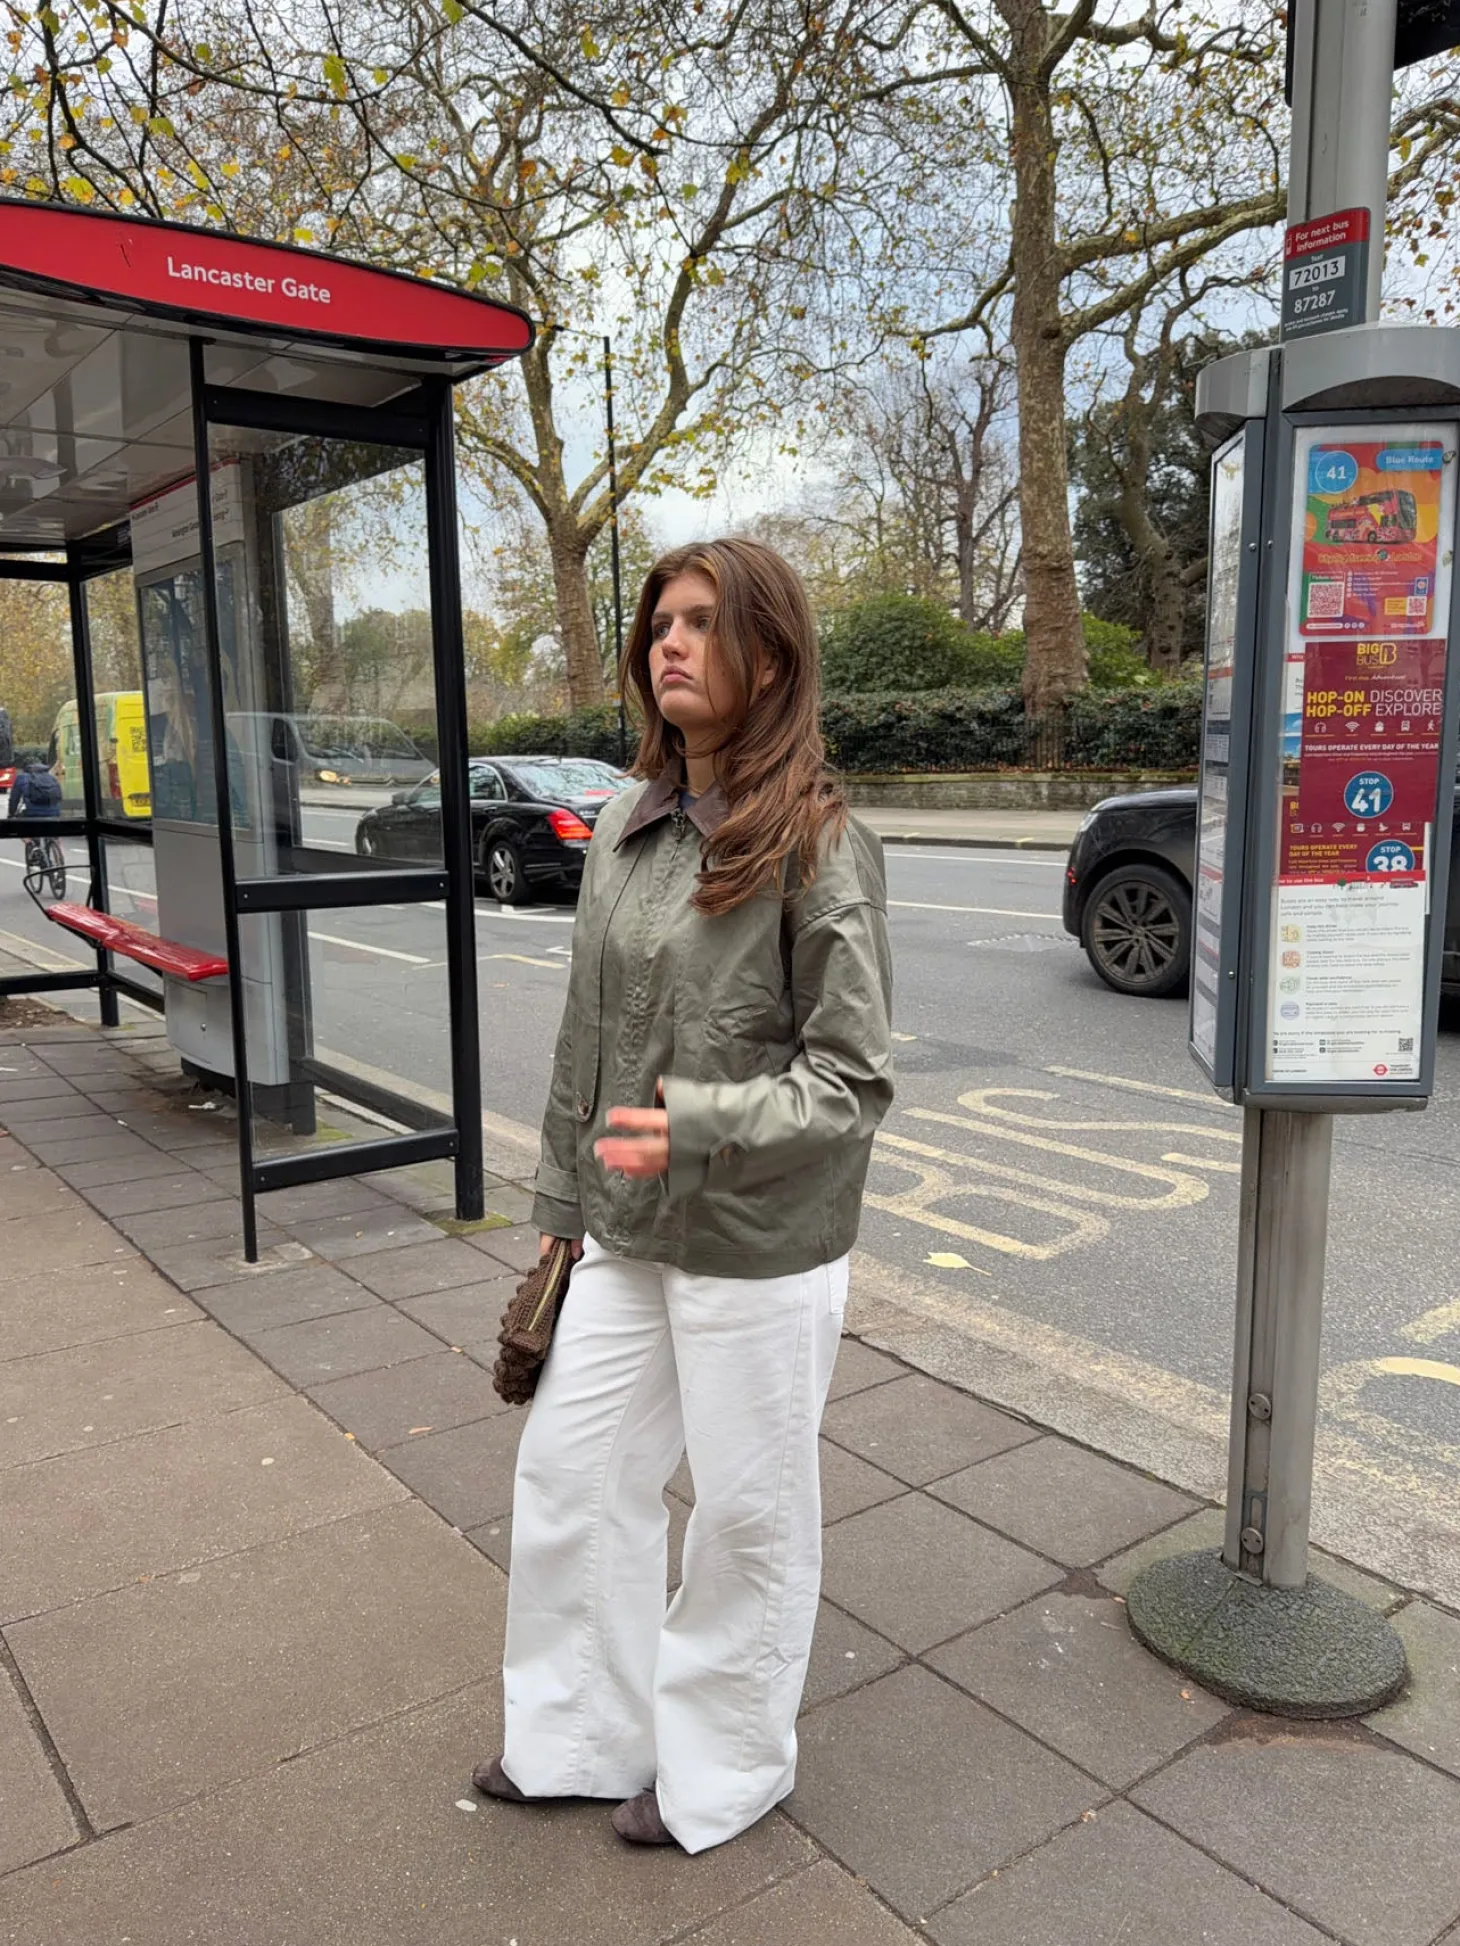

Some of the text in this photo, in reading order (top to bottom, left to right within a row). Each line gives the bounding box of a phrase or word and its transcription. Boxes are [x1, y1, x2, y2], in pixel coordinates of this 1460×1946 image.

[1295, 220, 1350, 242] For next bus
[1296, 231, 1346, 252] information
[167, 256, 331, 304] Lancaster Gate
[1294, 260, 1339, 286] 72013
[1294, 289, 1336, 314] 87287
[1385, 455, 1434, 465] Blue Route
[1326, 465, 1347, 480] 41
[1357, 643, 1379, 655] BIG
[1356, 655, 1379, 666] BUS
[1306, 688, 1443, 704] HOP-ON DISCOVER
[1306, 702, 1442, 718] HOP-OFF EXPLORE
[1360, 743, 1381, 751] EVERY
[1420, 742, 1439, 750] YEAR
[1351, 788, 1382, 813] 41
[1373, 855, 1408, 872] 38
[862, 1087, 1242, 1260] BUS
